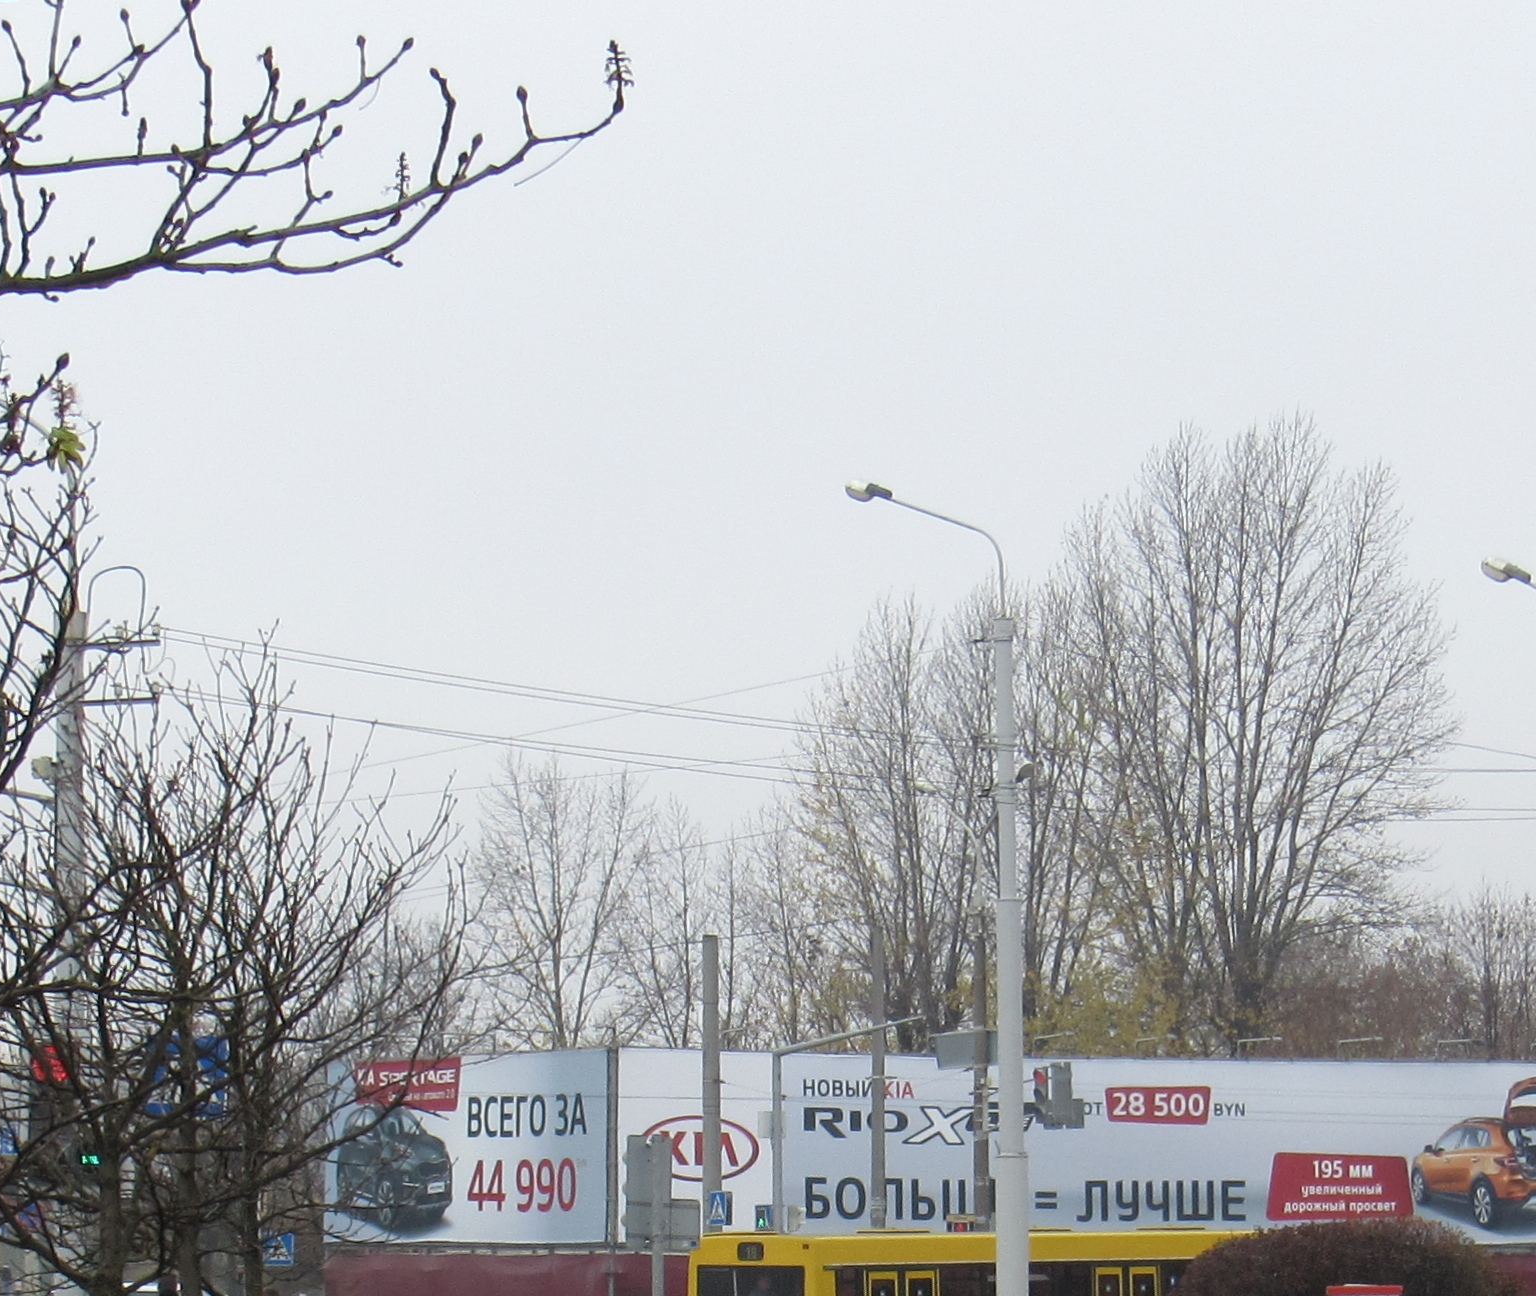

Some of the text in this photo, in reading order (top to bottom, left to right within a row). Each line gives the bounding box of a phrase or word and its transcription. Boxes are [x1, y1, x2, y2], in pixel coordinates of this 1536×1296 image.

[467, 1093, 587, 1138] ВСЕГО ЗА
[1111, 1092, 1146, 1117] 28
[1153, 1092, 1205, 1118] 500
[1213, 1103, 1246, 1117] BYN
[1313, 1160, 1374, 1179] 195 мм
[467, 1157, 577, 1213] 44 990
[1301, 1184, 1383, 1198] увеличенный
[1076, 1180, 1247, 1223] ЛУЧШЕ
[1283, 1200, 1397, 1214] дорожный просвет
